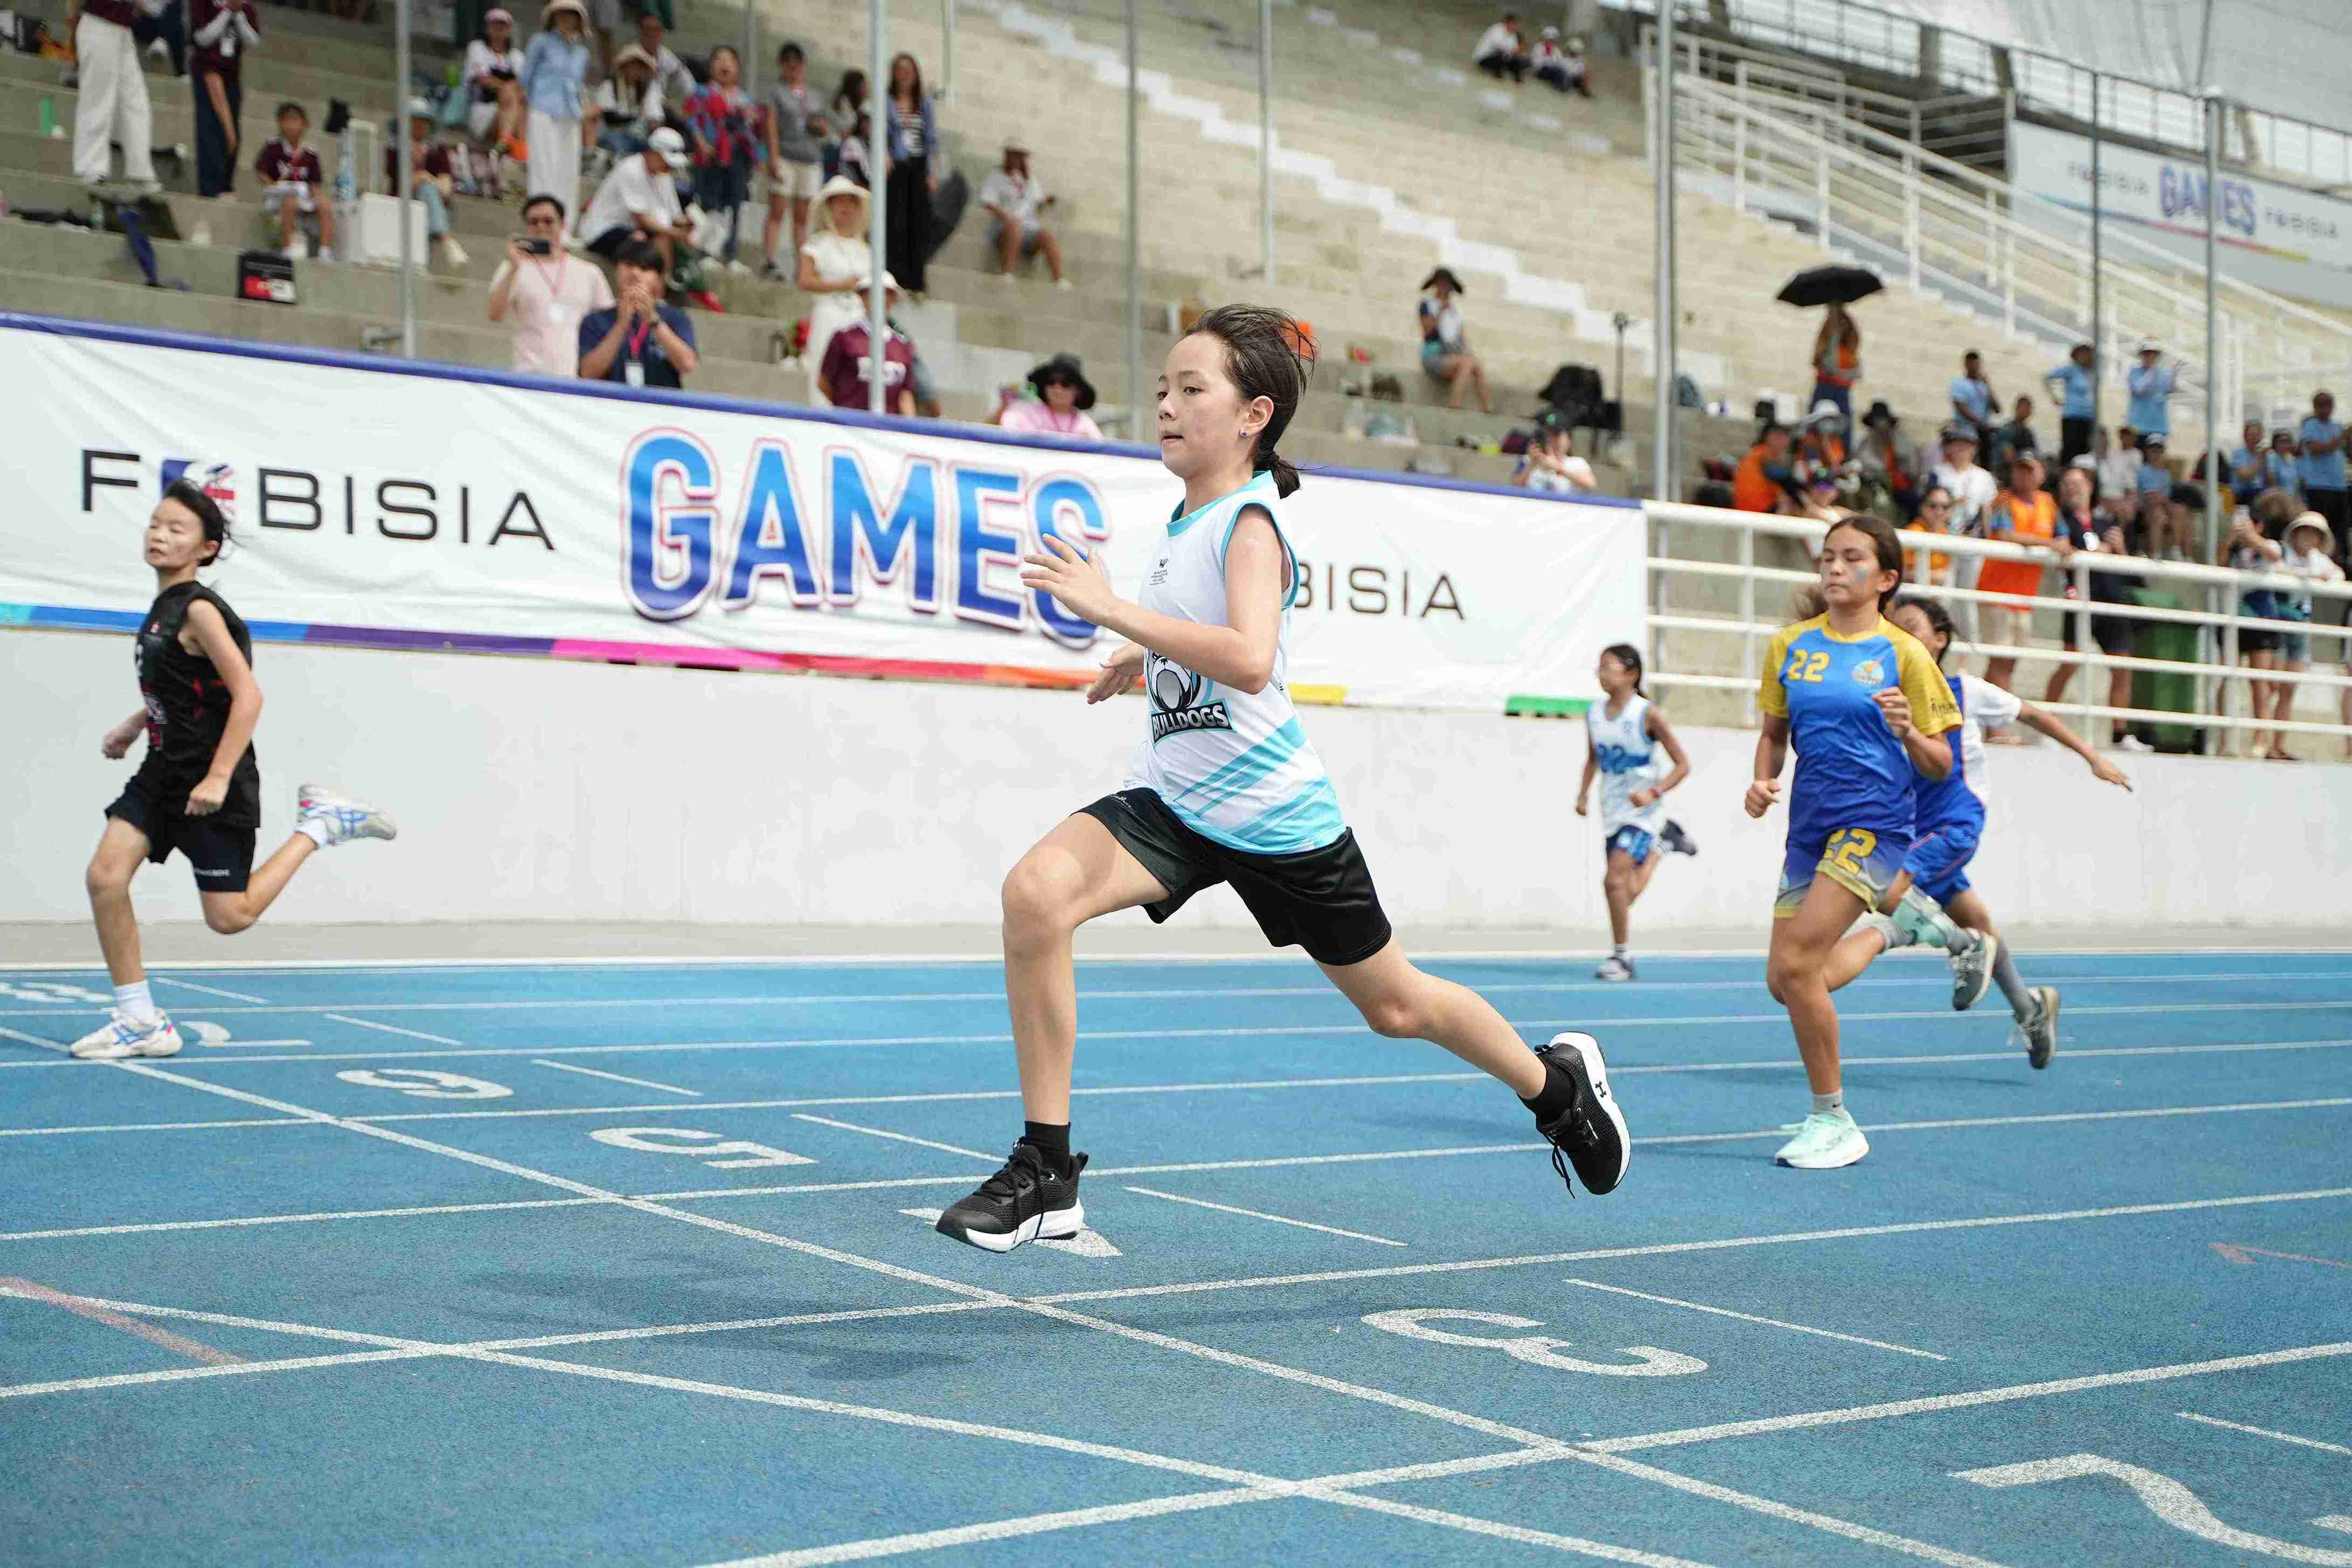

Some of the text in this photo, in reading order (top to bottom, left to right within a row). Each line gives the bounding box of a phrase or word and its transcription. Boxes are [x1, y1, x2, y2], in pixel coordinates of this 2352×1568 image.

[81, 448, 555, 551] FBISIA
[622, 428, 1111, 648] GAMES
[1787, 649, 1830, 683] 22
[1152, 704, 1229, 739] BULLDOGS
